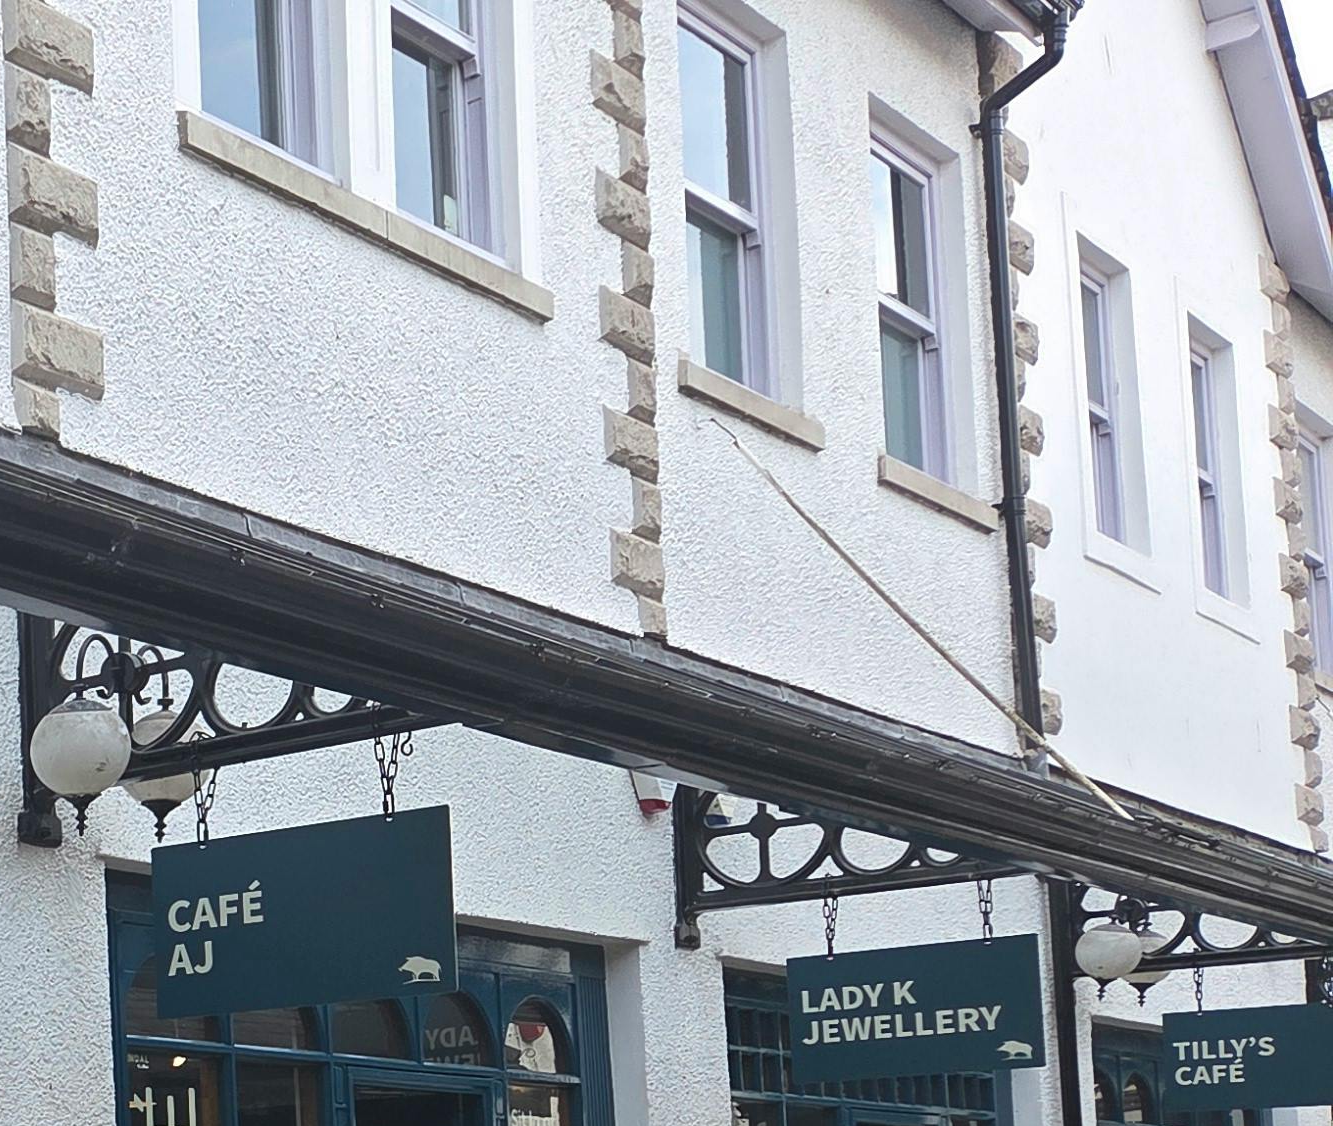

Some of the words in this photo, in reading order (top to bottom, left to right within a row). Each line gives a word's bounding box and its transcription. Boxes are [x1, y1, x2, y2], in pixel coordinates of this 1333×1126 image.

[167, 879, 266, 934] CAFÉ
[167, 940, 214, 978] AJ
[800, 982, 885, 1014] LADY
[893, 980, 917, 1006] K
[801, 1005, 1002, 1046] JEWELLERY
[1172, 1036, 1276, 1061] TILLY'S
[1174, 1058, 1246, 1087] CAFÉ
